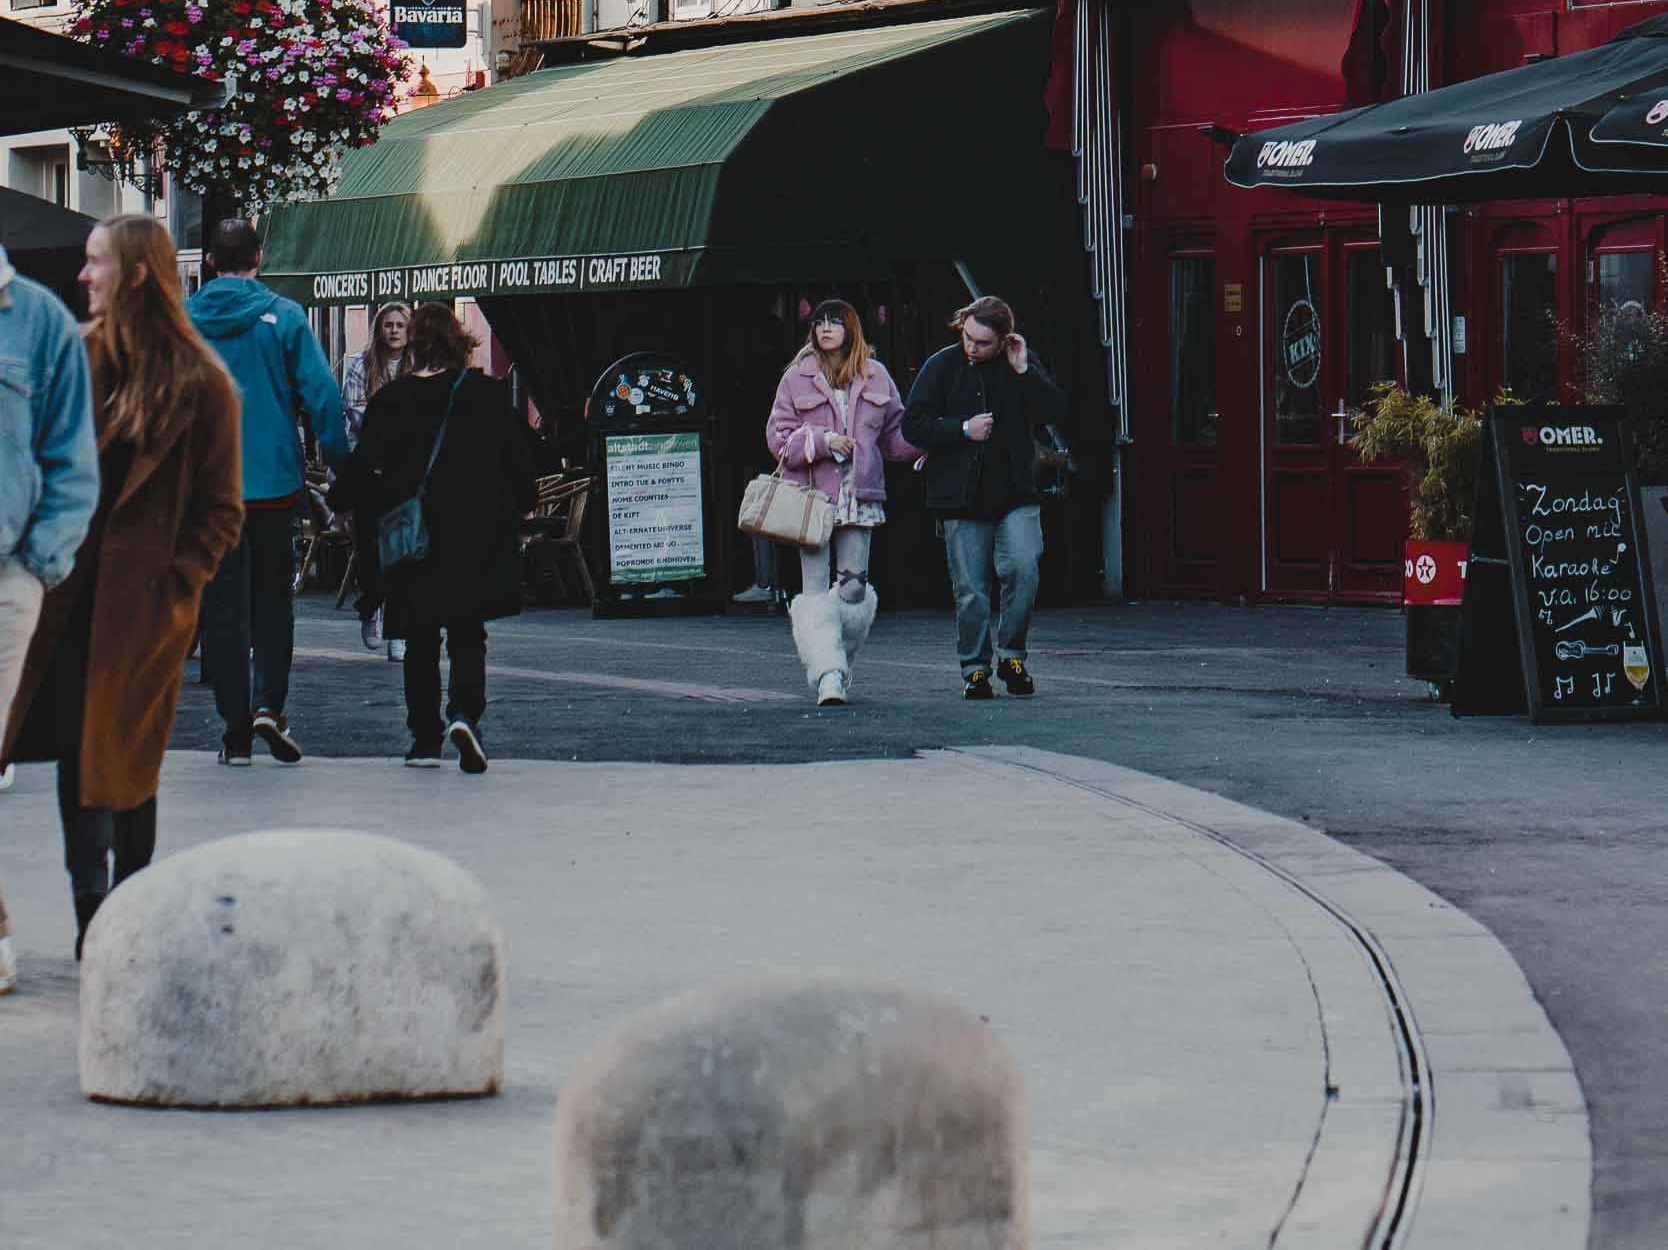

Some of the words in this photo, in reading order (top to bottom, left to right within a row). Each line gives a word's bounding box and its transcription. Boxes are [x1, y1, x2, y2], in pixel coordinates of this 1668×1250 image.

[394, 6, 463, 23] Bavaria
[313, 272, 368, 299] CONCERTS
[378, 270, 401, 296] DJ'S
[412, 266, 449, 293] DANCE
[450, 264, 488, 290] FLOOR
[499, 262, 530, 287] POOL
[533, 259, 577, 285] TABLES
[588, 258, 628, 283] CRAFT
[629, 255, 661, 281] BEER
[1288, 333, 1316, 365] KIX
[1539, 427, 1603, 445] OMER.
[637, 462, 660, 470] MUSIC
[662, 461, 685, 469] BINGO
[611, 480, 634, 488] INTRO
[634, 494, 669, 502] COUNTIES
[1526, 484, 1621, 526] Zondag
[1525, 524, 1574, 553] Open
[1532, 554, 1612, 579] Karaoke
[1585, 579, 1632, 603] 16:00
